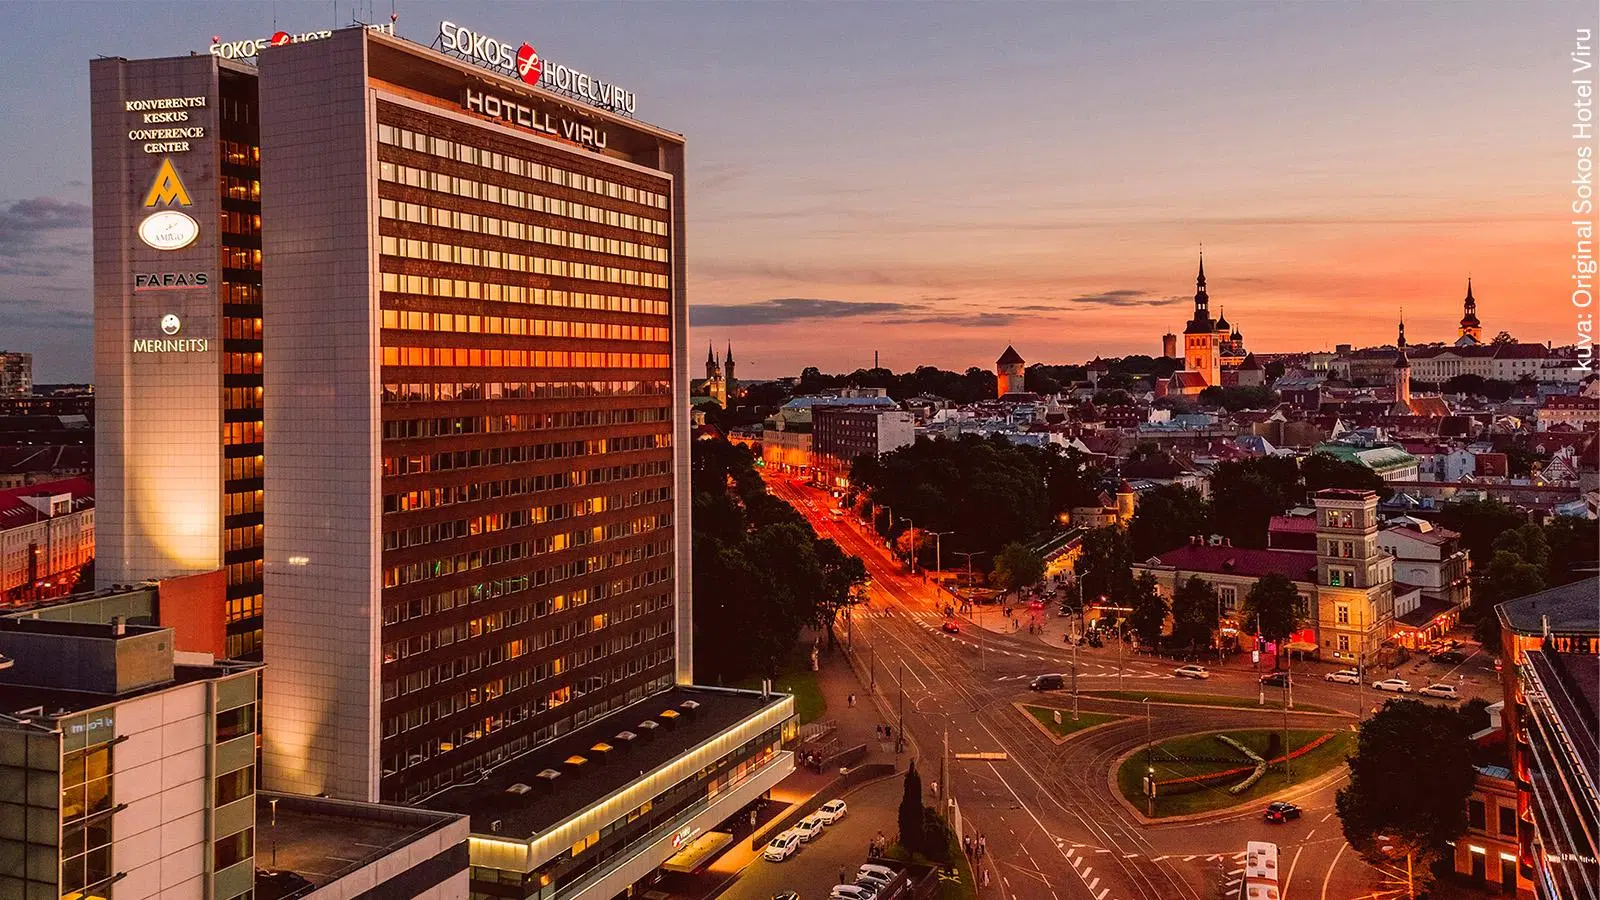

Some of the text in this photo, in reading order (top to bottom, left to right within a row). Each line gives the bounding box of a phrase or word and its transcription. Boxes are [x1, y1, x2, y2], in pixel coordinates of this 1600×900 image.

[441, 20, 636, 113] SOKOS HOTEL VIRU
[126, 97, 206, 111] KONVERENTSI
[143, 111, 189, 124] KESKUS
[466, 88, 607, 149] HOTELL VIRU
[128, 127, 204, 140] CONFERENCE
[144, 141, 190, 153] CENTER
[135, 273, 208, 286] FAFA'S
[133, 339, 208, 353] MERINEITSI
